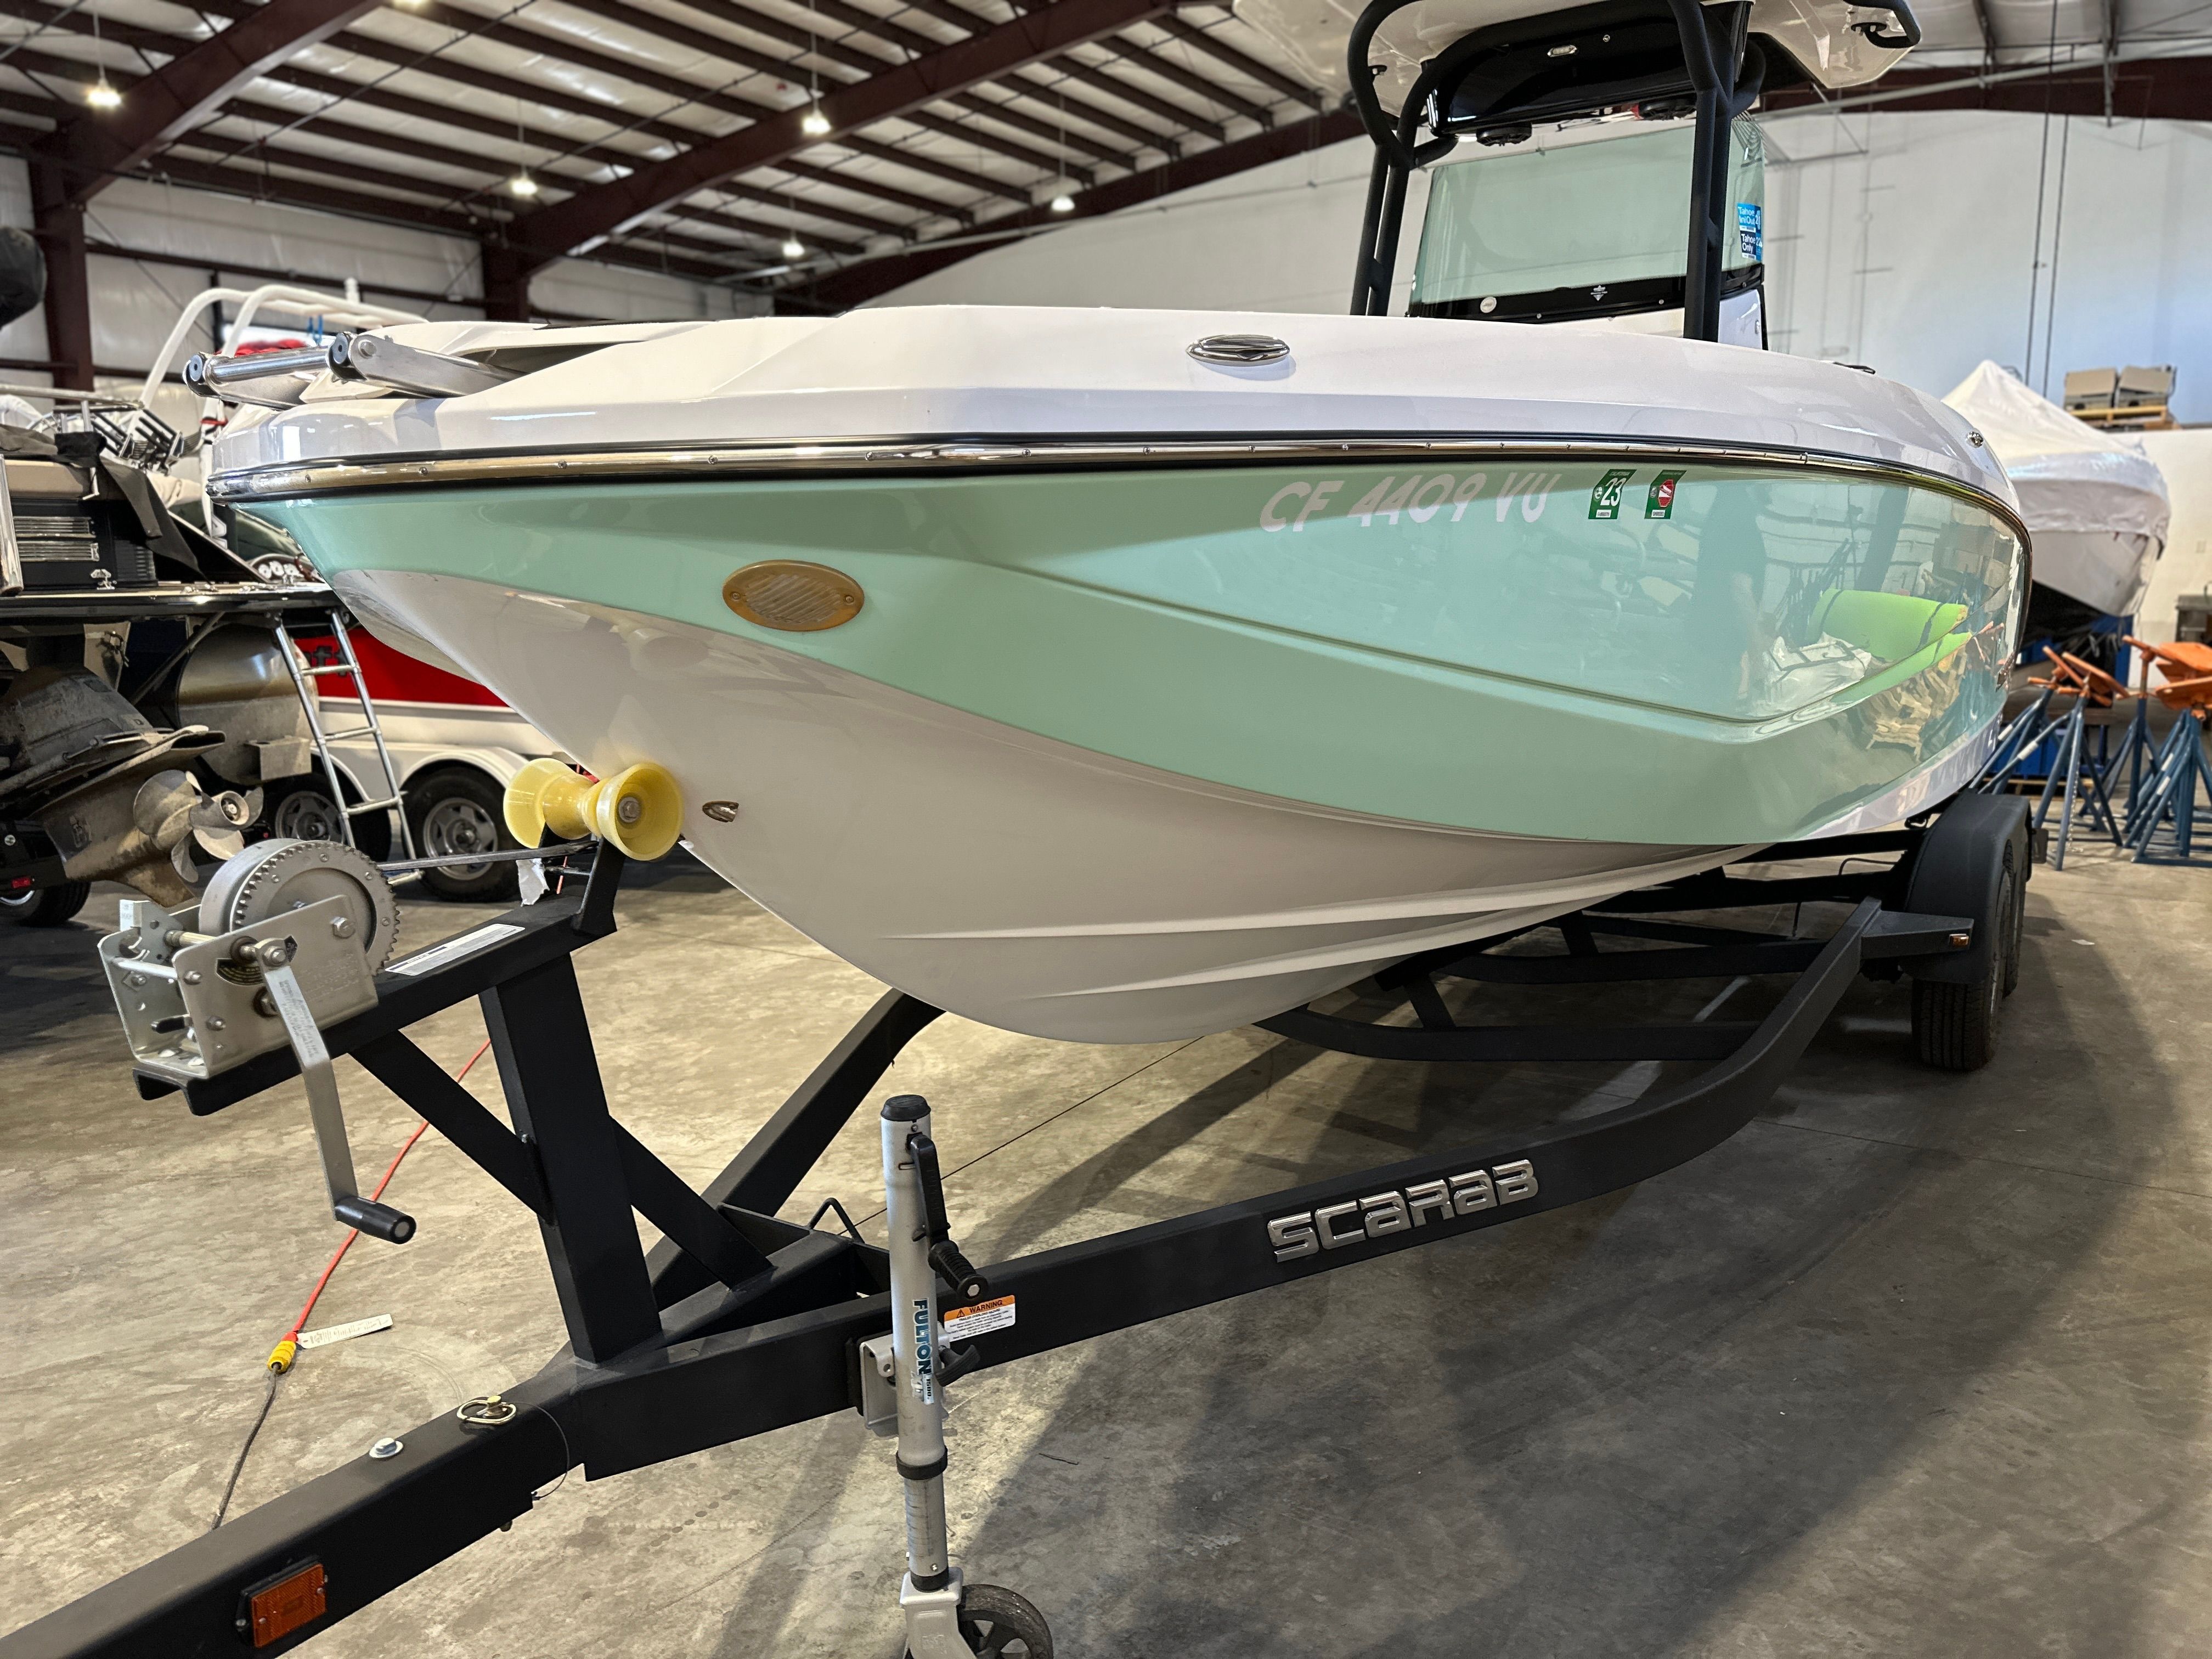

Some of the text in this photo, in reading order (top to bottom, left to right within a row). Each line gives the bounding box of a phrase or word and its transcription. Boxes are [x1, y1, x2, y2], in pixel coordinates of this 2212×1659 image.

[1738, 206, 1755, 216] Tahoe
[1741, 234, 1756, 245] Tahoe
[1742, 242, 1753, 253] Only
[1260, 472, 1562, 532] CF 4409 VU
[1600, 478, 1627, 506] 23
[1267, 1159, 1538, 1262] SCARAB
[969, 1300, 1003, 1313] WARNING
[912, 1298, 934, 1375] FULTON
